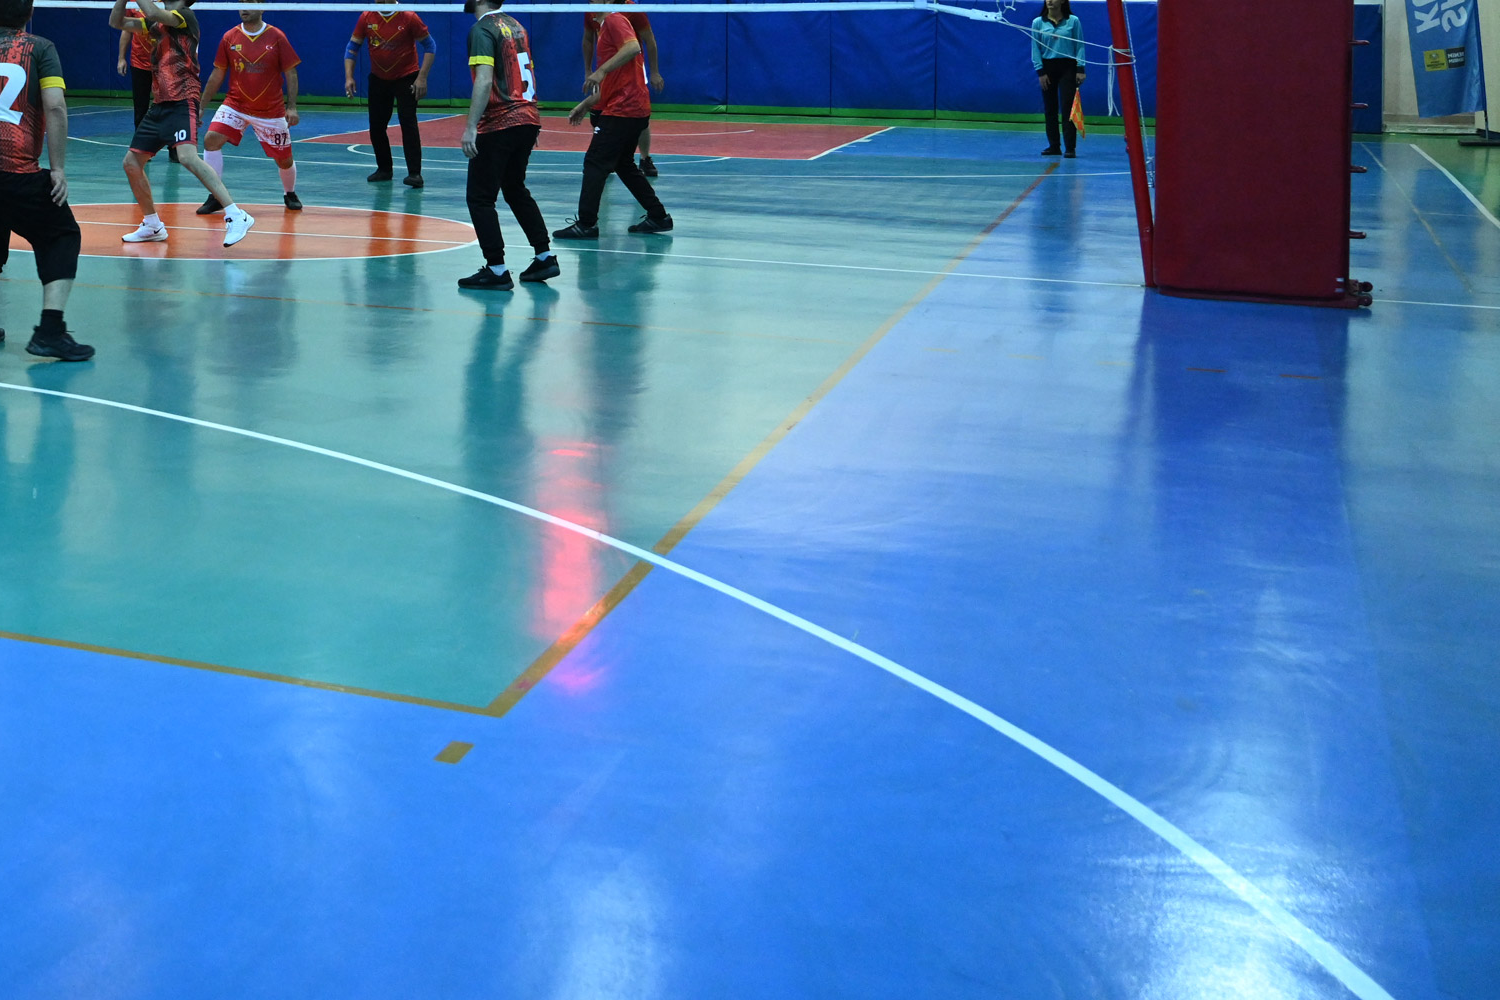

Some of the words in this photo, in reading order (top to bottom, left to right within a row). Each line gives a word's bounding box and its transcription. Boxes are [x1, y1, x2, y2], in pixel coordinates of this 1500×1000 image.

[516, 52, 536, 102] 5
[174, 130, 187, 142] 10
[274, 132, 288, 145] 87
